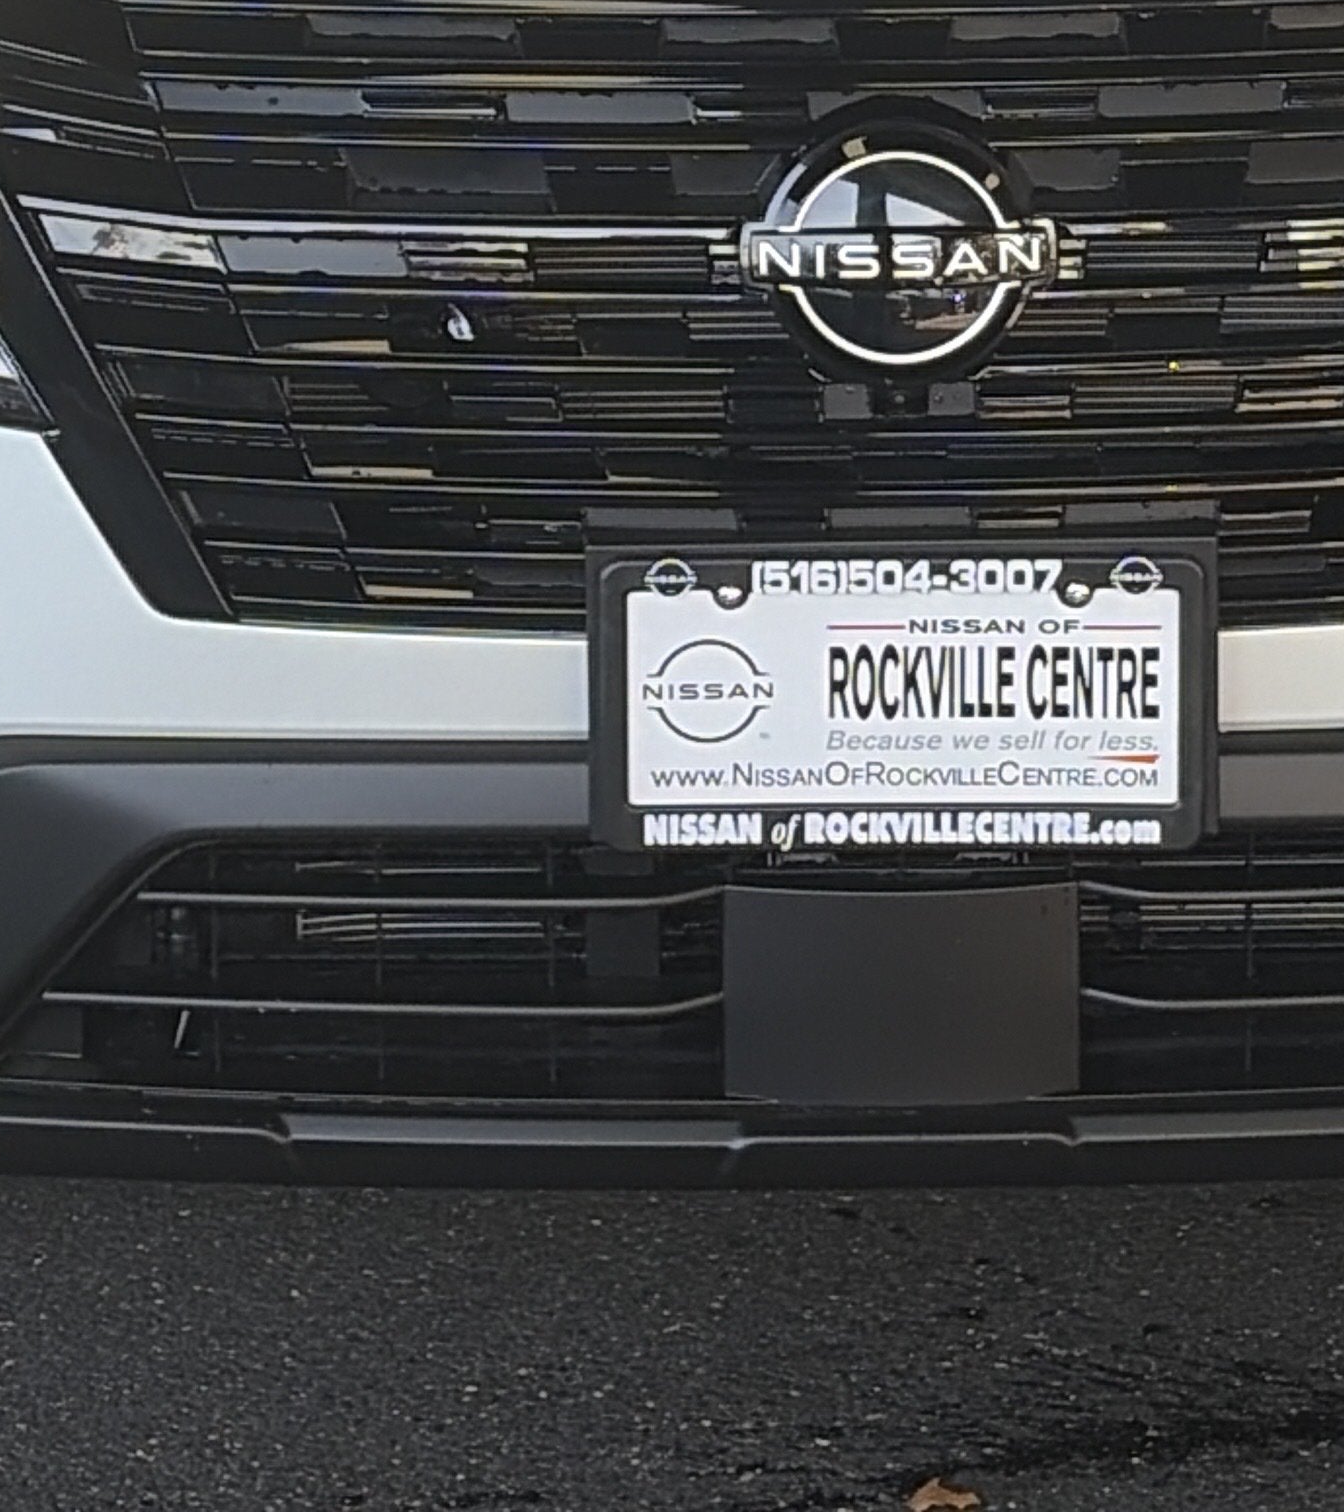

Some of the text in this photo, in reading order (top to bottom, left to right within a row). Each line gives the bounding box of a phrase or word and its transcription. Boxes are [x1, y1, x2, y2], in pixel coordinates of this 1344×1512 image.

[758, 238, 1042, 280] NISSAN
[751, 560, 1063, 595] (516)504-3007
[909, 619, 1080, 634] NISSAN OF
[642, 682, 773, 700] NISSAN
[828, 644, 1160, 720] ROCKVILLE CENTRE
[826, 729, 1158, 751] Because we sell for less.
[643, 811, 1162, 852] NISSAN of ROCKVILLECENTRE.com
